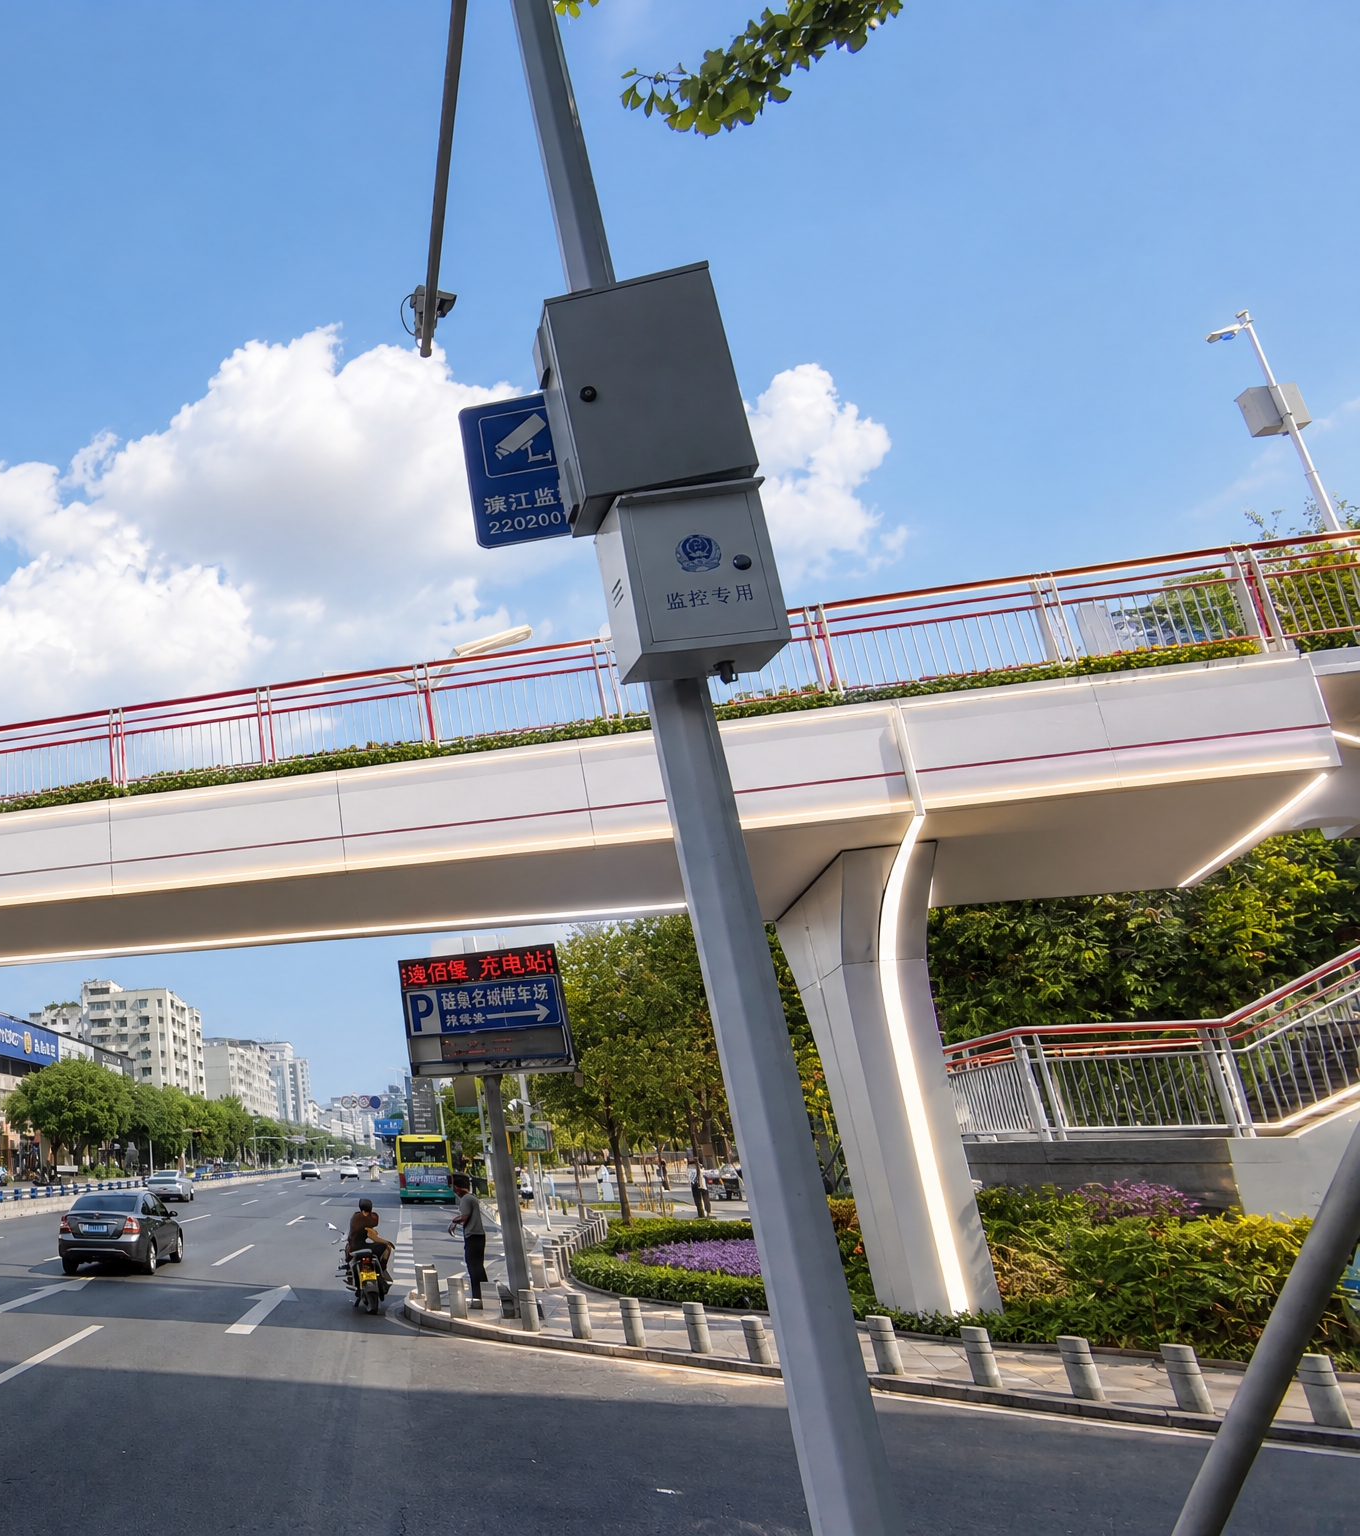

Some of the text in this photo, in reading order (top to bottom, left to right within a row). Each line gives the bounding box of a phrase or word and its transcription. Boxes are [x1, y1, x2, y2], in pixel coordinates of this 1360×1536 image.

[483, 486, 564, 516] 滨江监
[488, 511, 566, 535] 220200
[666, 583, 754, 611] 监控专用
[478, 950, 548, 978] 充电站
[409, 993, 434, 1032] P
